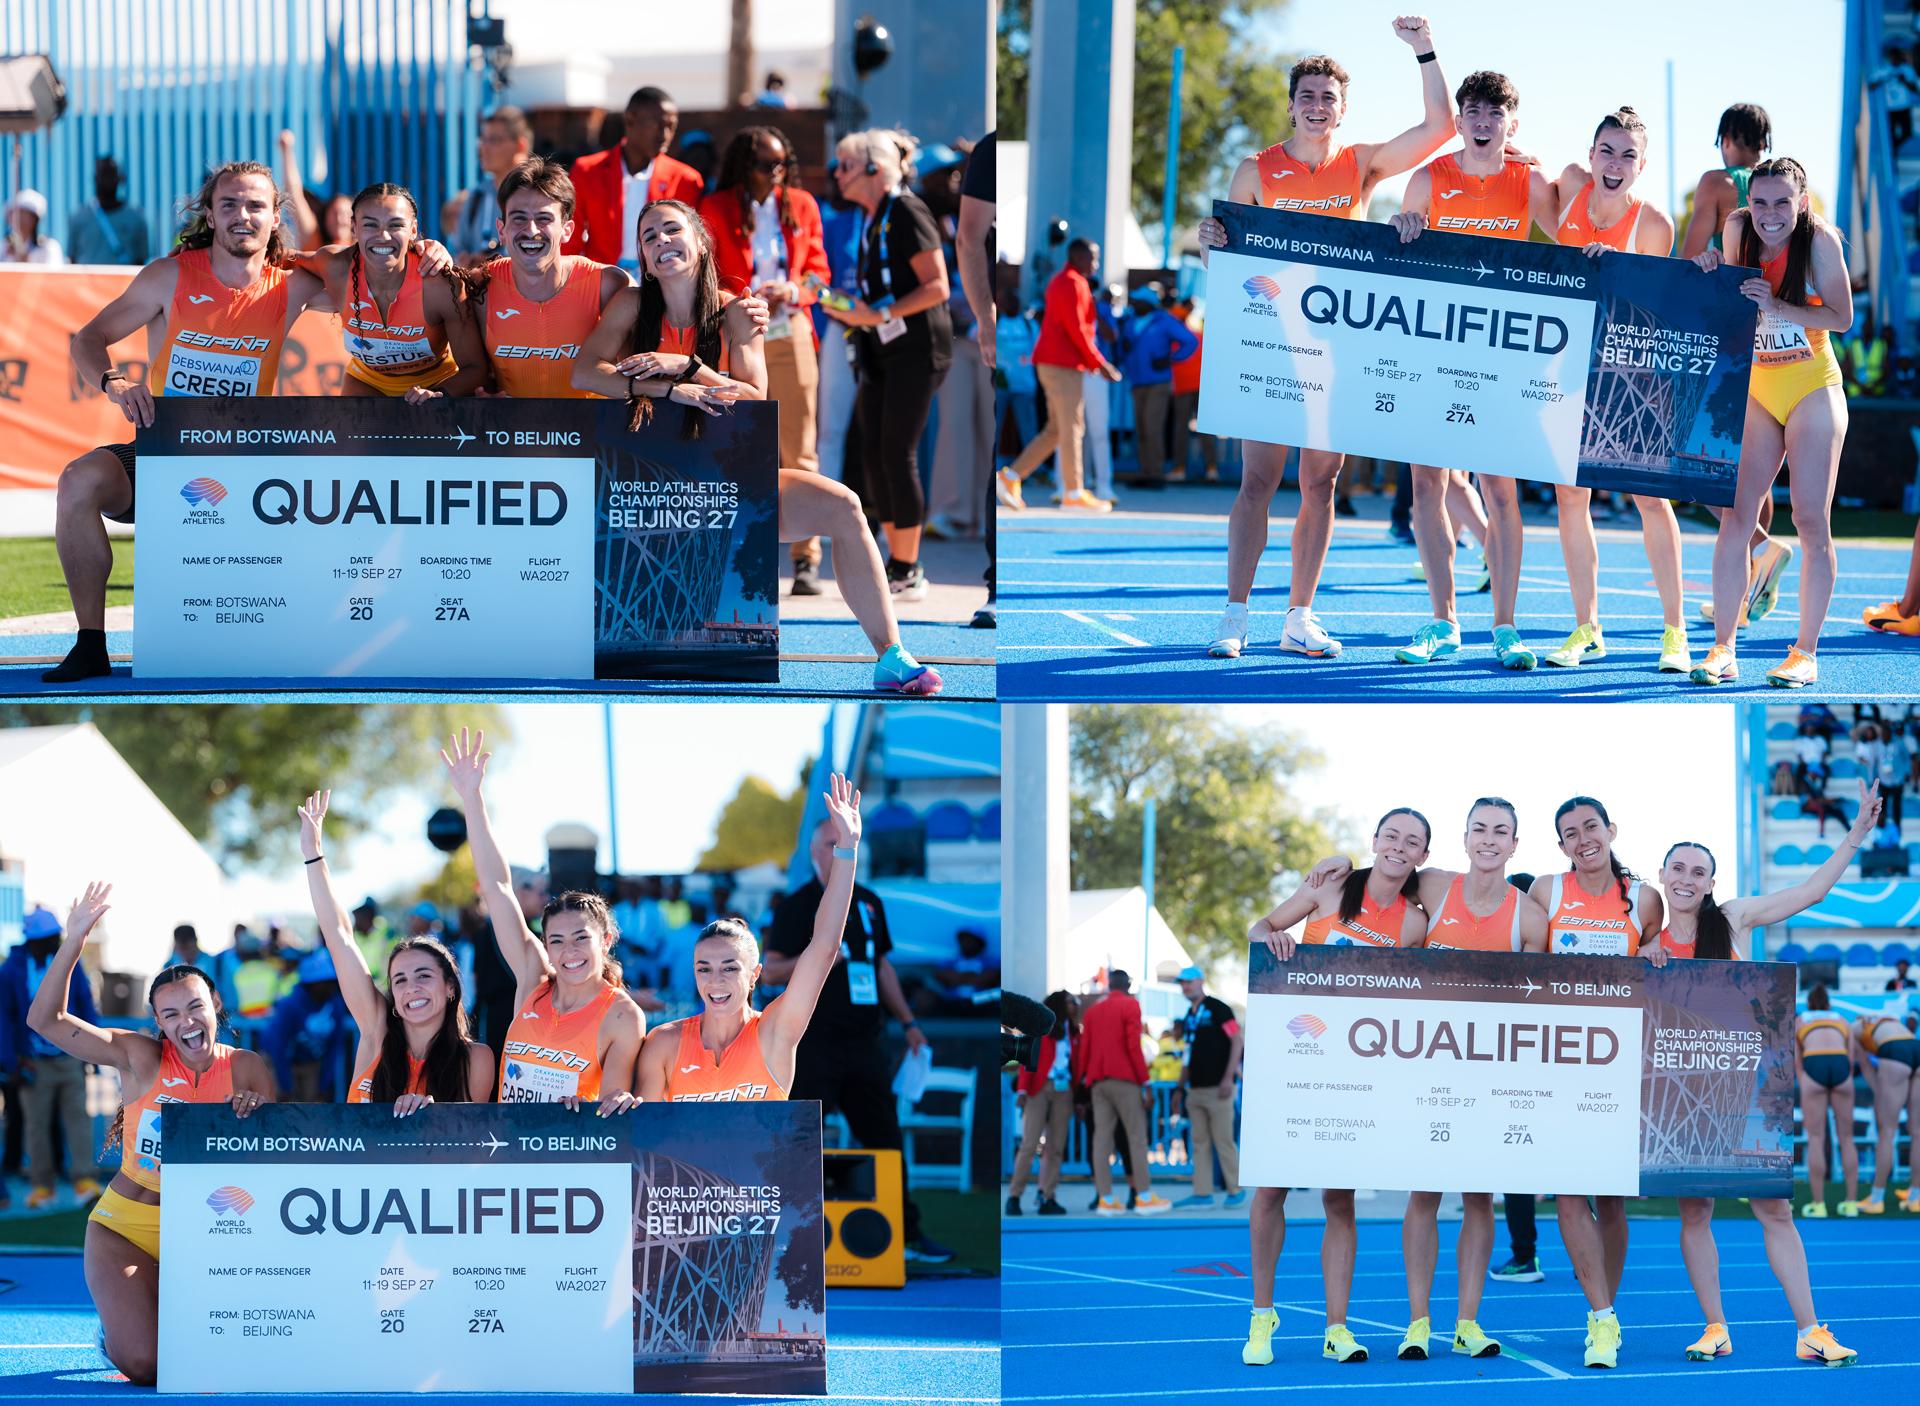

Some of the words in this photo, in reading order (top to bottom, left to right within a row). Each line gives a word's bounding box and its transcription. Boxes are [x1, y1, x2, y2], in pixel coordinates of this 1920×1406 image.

[1273, 194, 1352, 210] ESPAÑA
[1437, 216, 1520, 231] ESPAÑA
[1246, 234, 1287, 250] FROM
[1291, 240, 1374, 262] BOTSWANA
[1504, 268, 1523, 281] TO
[1528, 271, 1585, 288] BEIJING
[1243, 307, 1277, 317] ATHLETICS
[1248, 302, 1272, 310] WORLD
[348, 317, 425, 336] ESPAÑA
[1301, 285, 1568, 355] QUALIFIED
[176, 329, 271, 352] ESPAÑA
[1607, 323, 1650, 336] WORLD
[1652, 329, 1719, 346] ATHLETICS
[1754, 332, 1806, 350] EVILLA
[1242, 340, 1264, 348] NAME
[1278, 344, 1322, 356] PASSENGER
[1604, 334, 1718, 358] CHAMPIONSHIPS
[172, 354, 241, 376] DEBSWANA
[1379, 359, 1398, 367] DATE
[1603, 346, 1682, 371] BEIJING
[1689, 358, 1716, 375] 27
[1364, 367, 1384, 377] 11-19
[1387, 370, 1406, 379] SEP
[1409, 373, 1421, 382] 27
[1438, 367, 1478, 378] BOARDING
[1480, 373, 1498, 381] TIME
[172, 371, 252, 396] CRESPI
[1266, 376, 1324, 392] BOTSWANA
[1455, 380, 1479, 390] 10:20
[1530, 380, 1557, 388] FLIGHT
[1266, 389, 1304, 402] BEIJING
[1376, 392, 1395, 400] GATE
[1522, 390, 1564, 402] WA2027
[1376, 400, 1394, 412] 20
[1446, 410, 1475, 424] 27A
[181, 430, 231, 443] FROM
[237, 430, 336, 443] BOTSWANA
[486, 432, 509, 444] TO
[515, 432, 580, 445] BEIJING
[610, 482, 659, 492] WORLD
[663, 482, 738, 493] ATHLETICS
[253, 479, 567, 526] QUALIFIED
[610, 495, 738, 508] CHAMPIONSHIPS
[610, 510, 700, 528] BEIJING
[708, 510, 738, 528] 27
[421, 557, 468, 565] BOARDING
[529, 558, 561, 566] FLIGHT
[333, 568, 358, 578] 11-19
[362, 568, 384, 578] SEP
[388, 569, 402, 578] 27
[441, 569, 470, 579] 10:20
[520, 571, 569, 581] WA2027
[216, 597, 286, 607] BOTSWANA
[216, 613, 264, 623] BEIJING
[350, 607, 372, 620] 20
[436, 607, 470, 620] 27A
[1559, 916, 1626, 929] ESPAÑA
[1288, 973, 1331, 985] FROM
[1336, 974, 1421, 988] BOTSWANA
[1550, 983, 1570, 994] TO
[1575, 984, 1631, 997] BEIJING
[1655, 1028, 1696, 1038] WORLD
[1700, 1030, 1762, 1041] ATHLETICS
[1348, 1018, 1618, 1065] QUALIFIED
[1655, 1040, 1762, 1053] CHAMPIONSHIPS
[1654, 1052, 1730, 1070] BEIJING
[1737, 1055, 1761, 1071] 27
[1492, 1089, 1532, 1097] BOARDING
[1416, 1097, 1438, 1106] 11-19
[1441, 1098, 1460, 1106] SEP
[1464, 1098, 1476, 1107] 27
[1510, 1100, 1535, 1109] 10:20
[1577, 1103, 1618, 1112] WA2027
[1315, 1118, 1375, 1128] BOTSWANA
[1314, 1132, 1356, 1142] BEIJING
[1431, 1130, 1450, 1142] 20
[1504, 1132, 1533, 1144] 27A
[207, 1137, 258, 1151] FROM
[264, 1138, 365, 1151] BOTSWANA
[519, 1137, 543, 1150] TO
[549, 1137, 616, 1150] BEIJING
[647, 1187, 698, 1198] WORLD
[702, 1186, 780, 1198] ATHLETICS
[280, 1188, 604, 1235] QUALIFIED
[647, 1200, 780, 1213] CHAMPIONSHIPS
[647, 1216, 741, 1234] BEIJING
[750, 1216, 780, 1234] 27
[363, 1280, 388, 1290] 11-19
[392, 1280, 416, 1290] SEP
[420, 1280, 434, 1290] 27
[475, 1280, 504, 1290] 10:20
[556, 1281, 606, 1291] WA2027
[244, 1310, 315, 1320] BOTSWANA
[244, 1326, 292, 1336] BEIJING
[381, 1319, 404, 1333] 20
[469, 1319, 504, 1332] 27A
